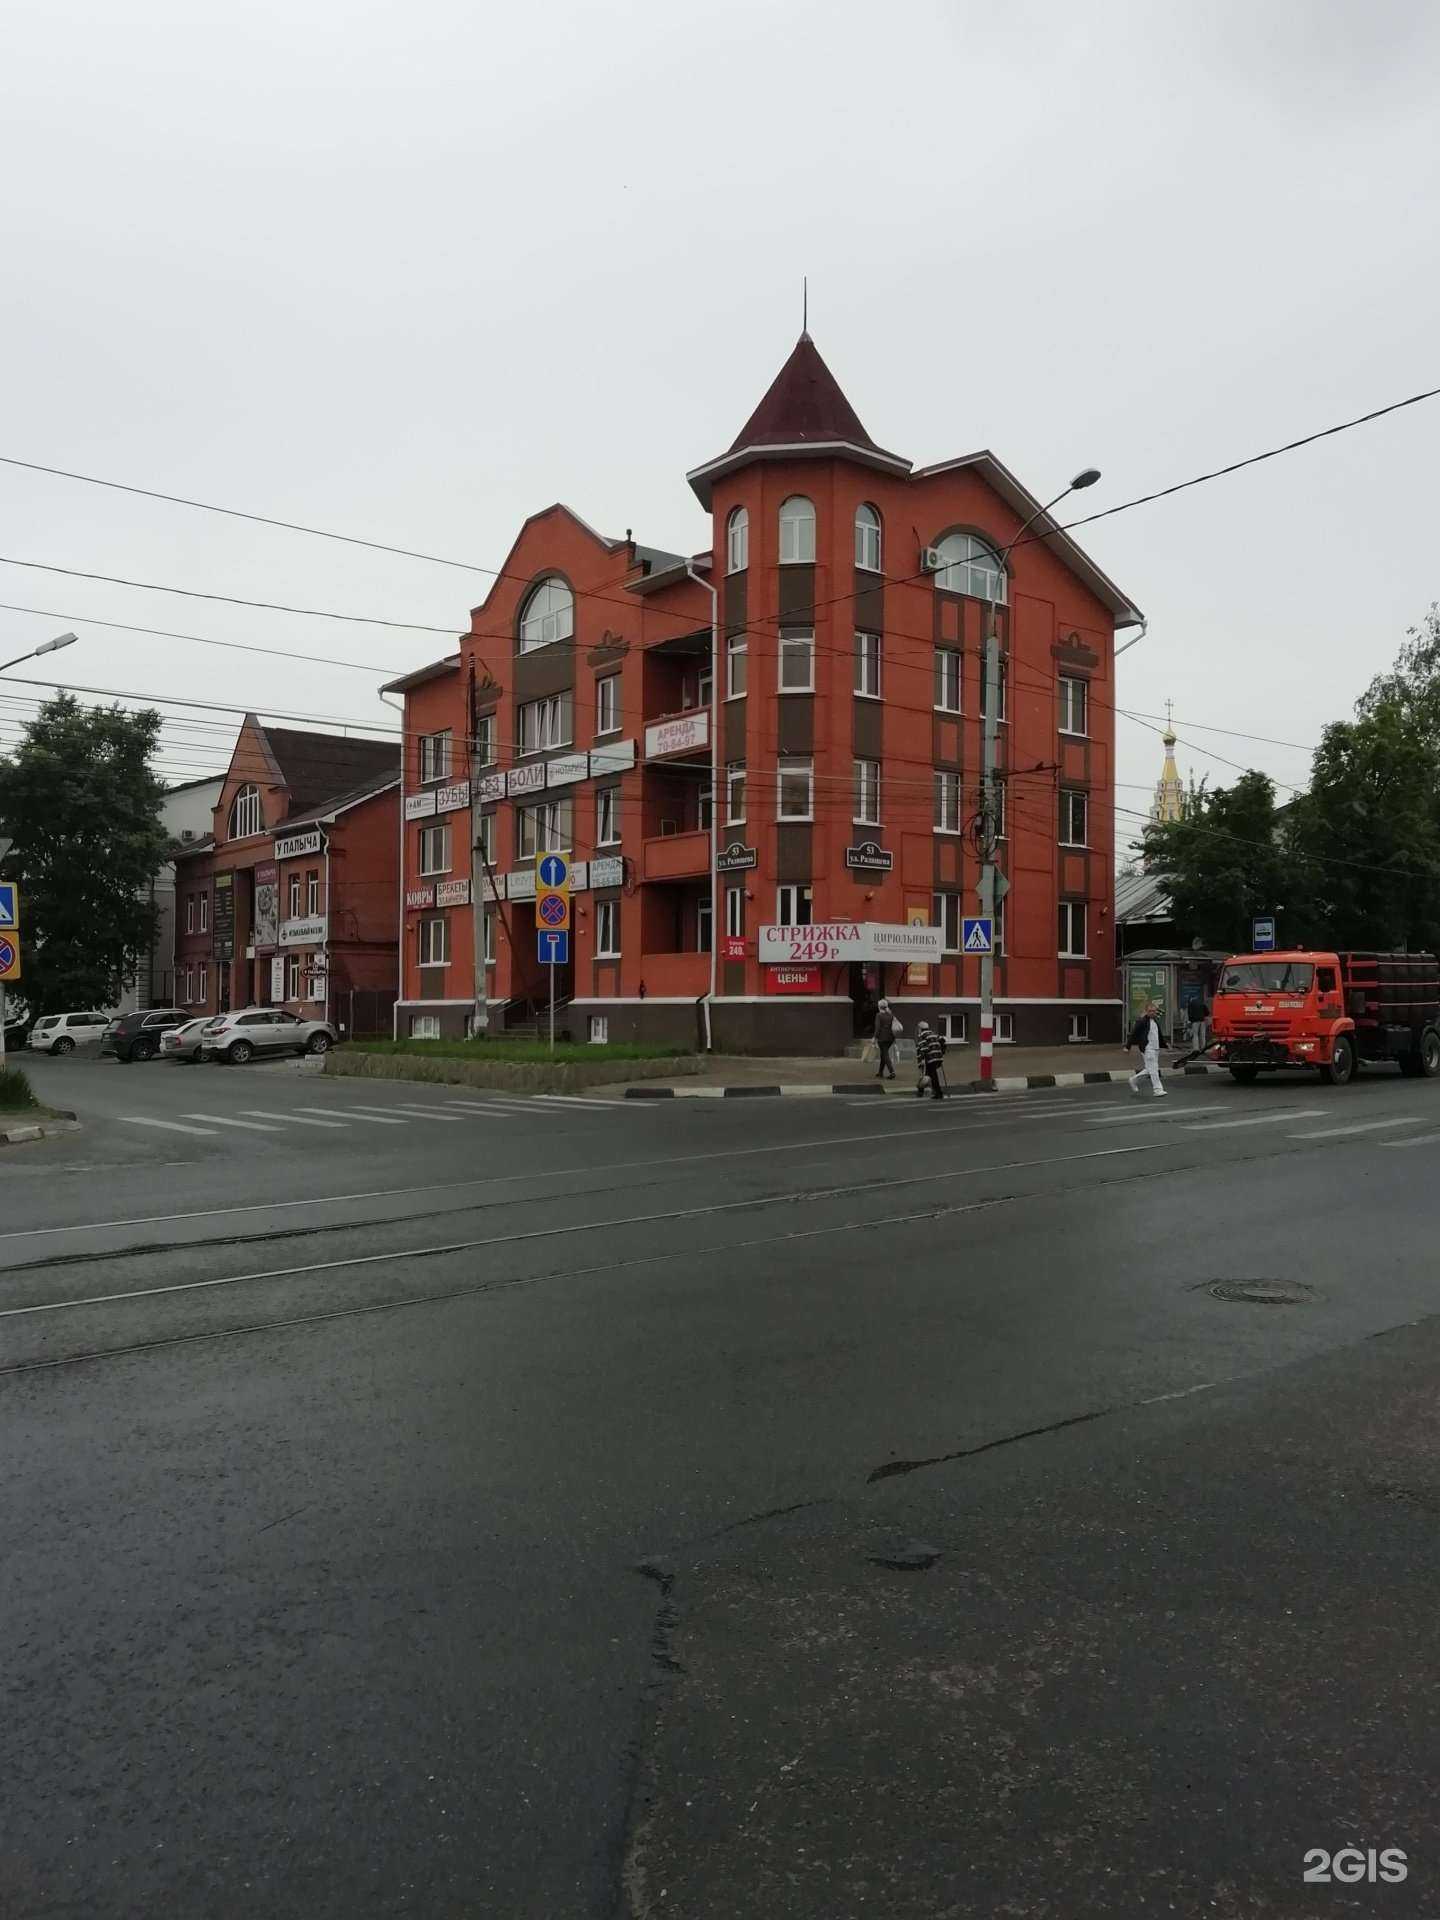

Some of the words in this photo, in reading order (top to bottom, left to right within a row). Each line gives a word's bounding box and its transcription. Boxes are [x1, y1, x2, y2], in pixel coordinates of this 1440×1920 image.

[657, 721, 695, 741] АРЕНДА
[438, 782, 469, 806] ЗУБЫ
[508, 765, 543, 789] БОЛИ
[277, 843, 282, 855] У
[283, 835, 318, 854] ПАЛЫЧА
[731, 847, 740, 856] 53
[866, 846, 875, 855] 53
[438, 881, 468, 895] БРЕКЕТЫ
[406, 890, 433, 906] КОВРЫ
[766, 926, 861, 942] СТРИЖКА
[873, 932, 937, 945] ЦИРЮЛЬНИКЪ
[789, 942, 828, 960] 249
[777, 973, 808, 984] ЦЕНЫ
